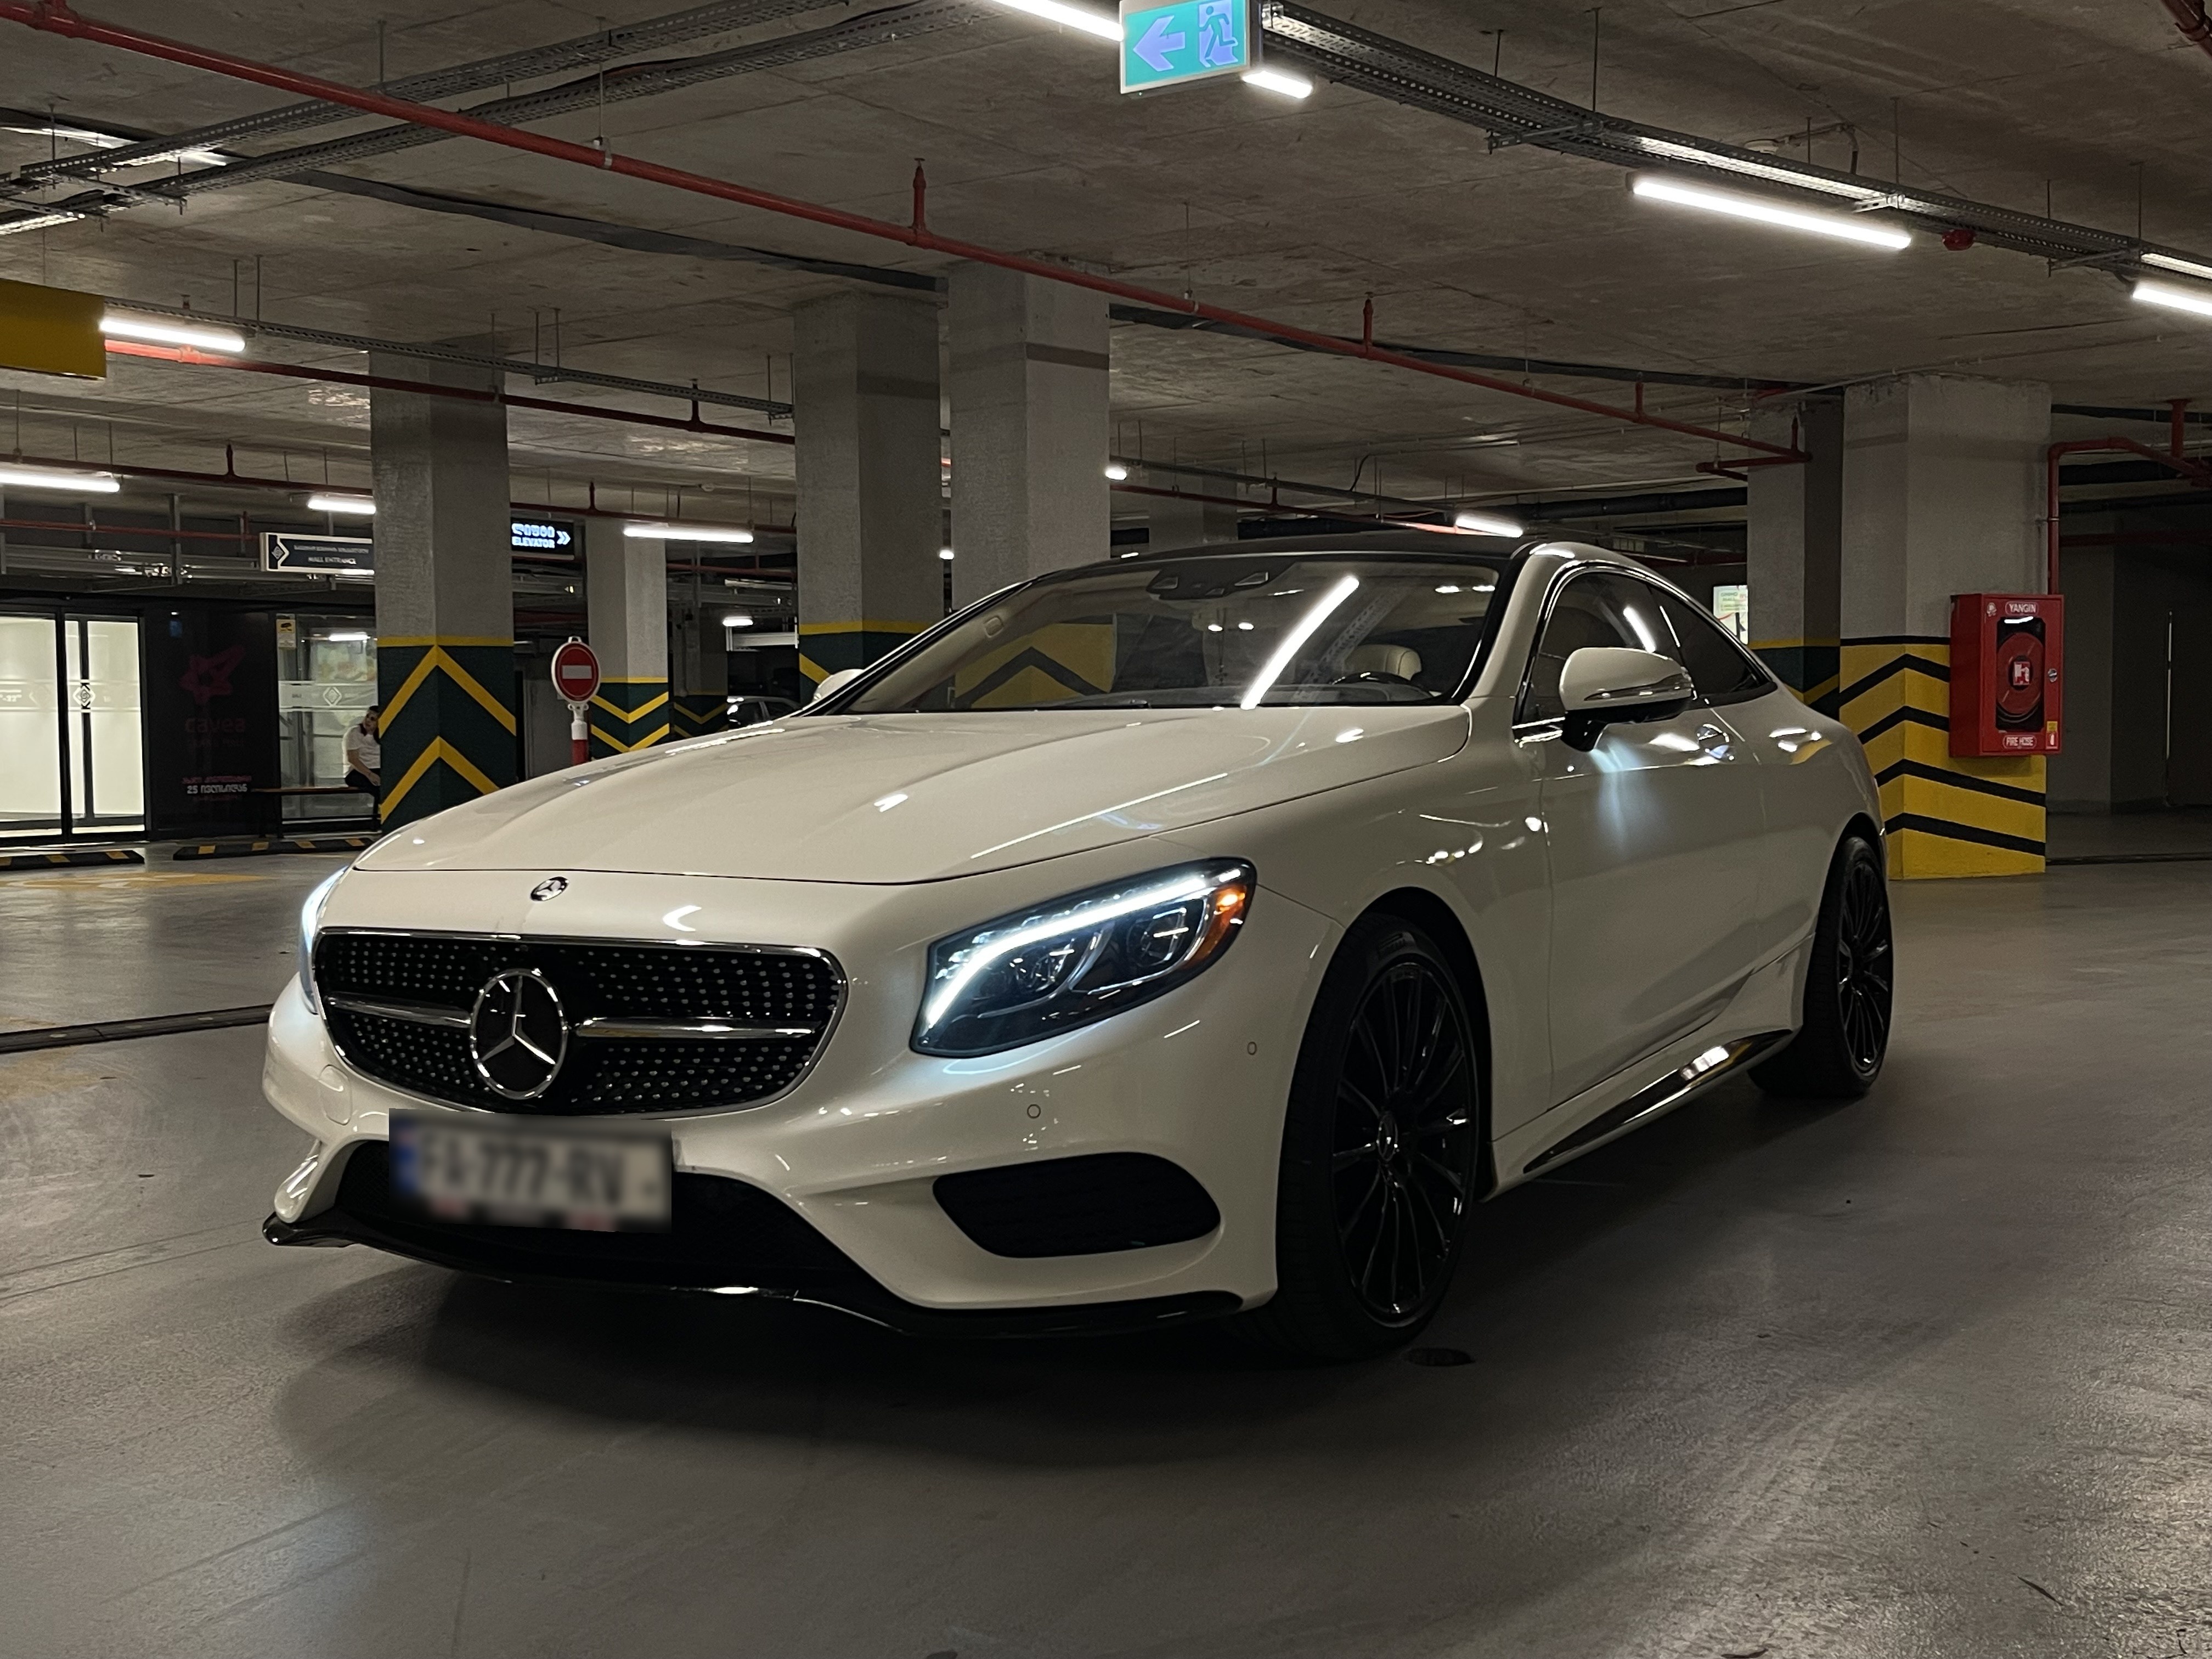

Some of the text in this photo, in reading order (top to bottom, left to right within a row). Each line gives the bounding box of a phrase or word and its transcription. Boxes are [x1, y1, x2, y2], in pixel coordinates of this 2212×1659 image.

[512, 537, 555, 548] ELEVATOR
[2008, 603, 2036, 613] YANGIN
[2006, 737, 2034, 746] FIRE HOSE
[187, 786, 198, 794] 25
